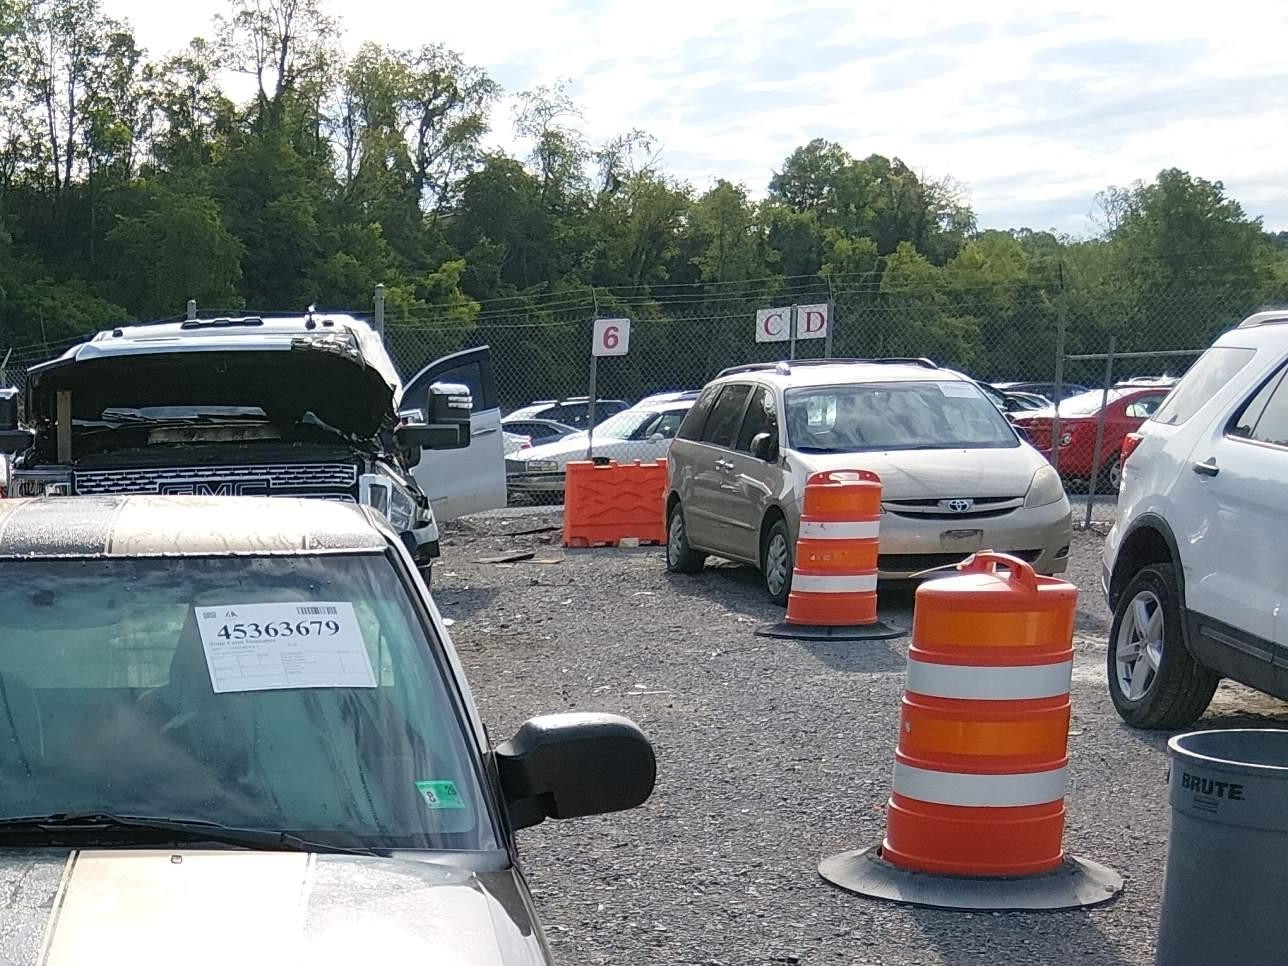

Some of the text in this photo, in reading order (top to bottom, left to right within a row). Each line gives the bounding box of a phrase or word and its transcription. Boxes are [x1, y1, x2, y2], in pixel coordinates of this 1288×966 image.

[764, 314, 783, 336] C
[805, 311, 824, 332] D
[602, 326, 619, 349] 6
[217, 620, 340, 640] 45363679
[1182, 772, 1244, 800] BRUTE
